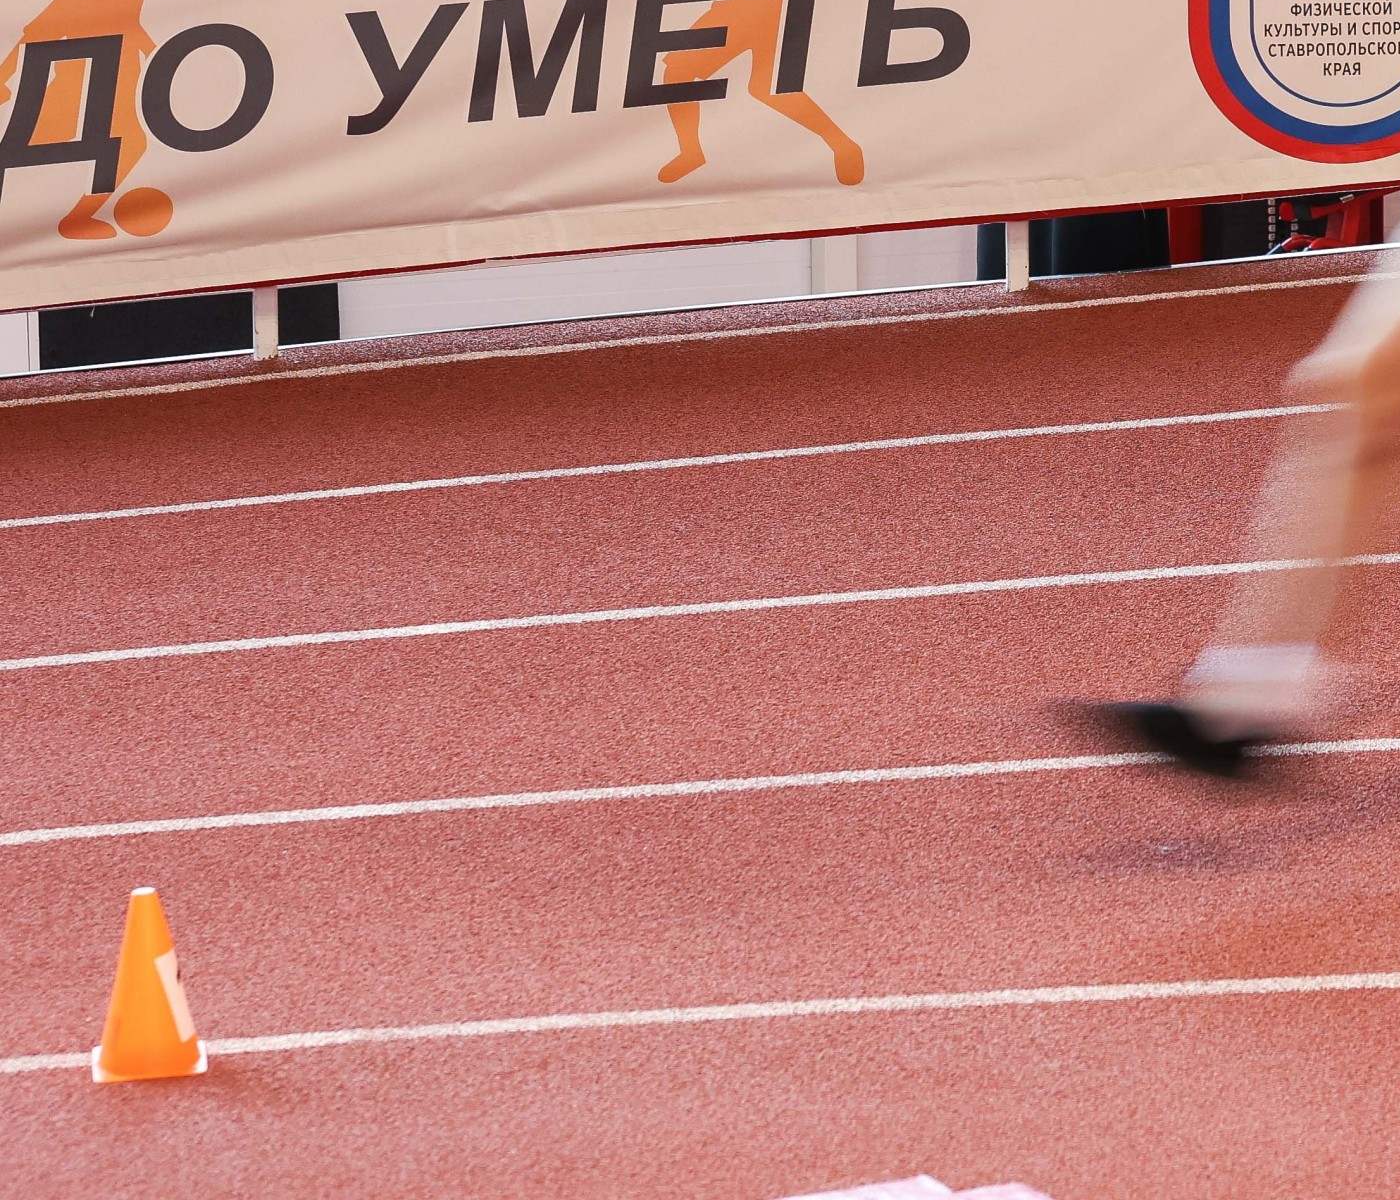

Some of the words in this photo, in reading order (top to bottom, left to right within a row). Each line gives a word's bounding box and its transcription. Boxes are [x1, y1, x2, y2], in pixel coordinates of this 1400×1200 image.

[1264, 22, 1342, 37] КУЛЬТУРЫ
[1347, 22, 1357, 36] И
[1323, 62, 1361, 76] КРАЯ
[0, 23, 274, 202] ДО
